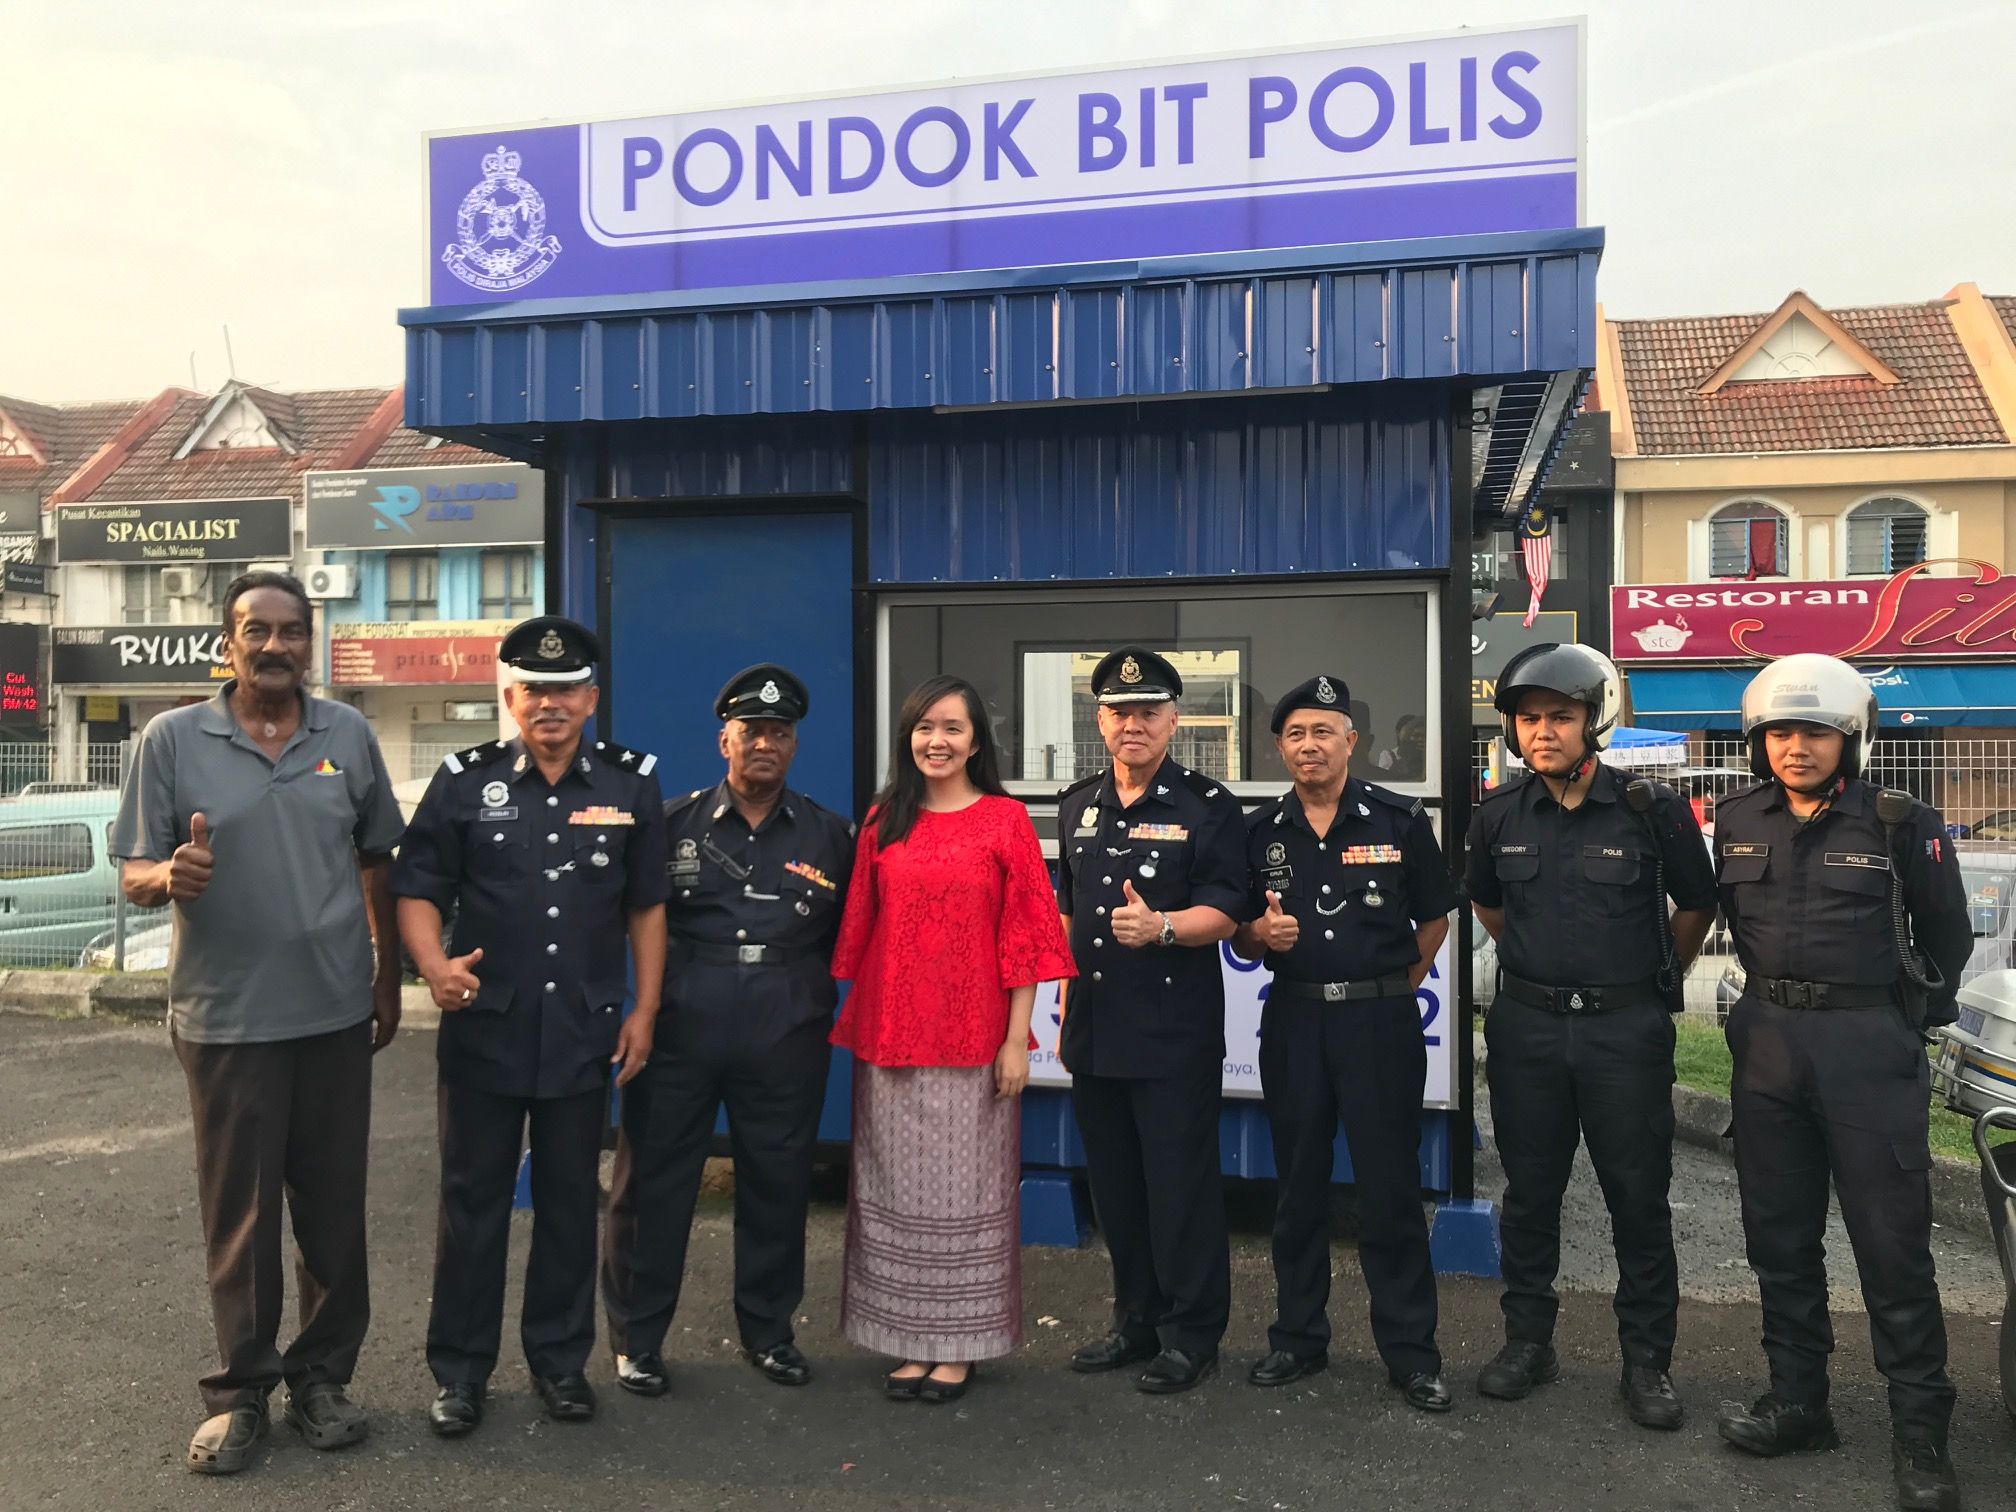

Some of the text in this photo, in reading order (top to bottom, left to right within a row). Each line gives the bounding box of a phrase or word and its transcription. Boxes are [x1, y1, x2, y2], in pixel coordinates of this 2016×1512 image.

[622, 50, 1543, 212] PONDOK BIT POLIS
[61, 507, 141, 520] Pusat Kecantikan
[106, 518, 240, 543] SPACIALIST
[1627, 558, 2016, 660] Restoran Sil
[1651, 635, 1673, 648] stc
[1501, 845, 1527, 853] GREGORY
[1602, 848, 1623, 857] POLIS
[1845, 856, 1869, 864] POLIS
[1223, 1062, 1257, 1077] aya,
